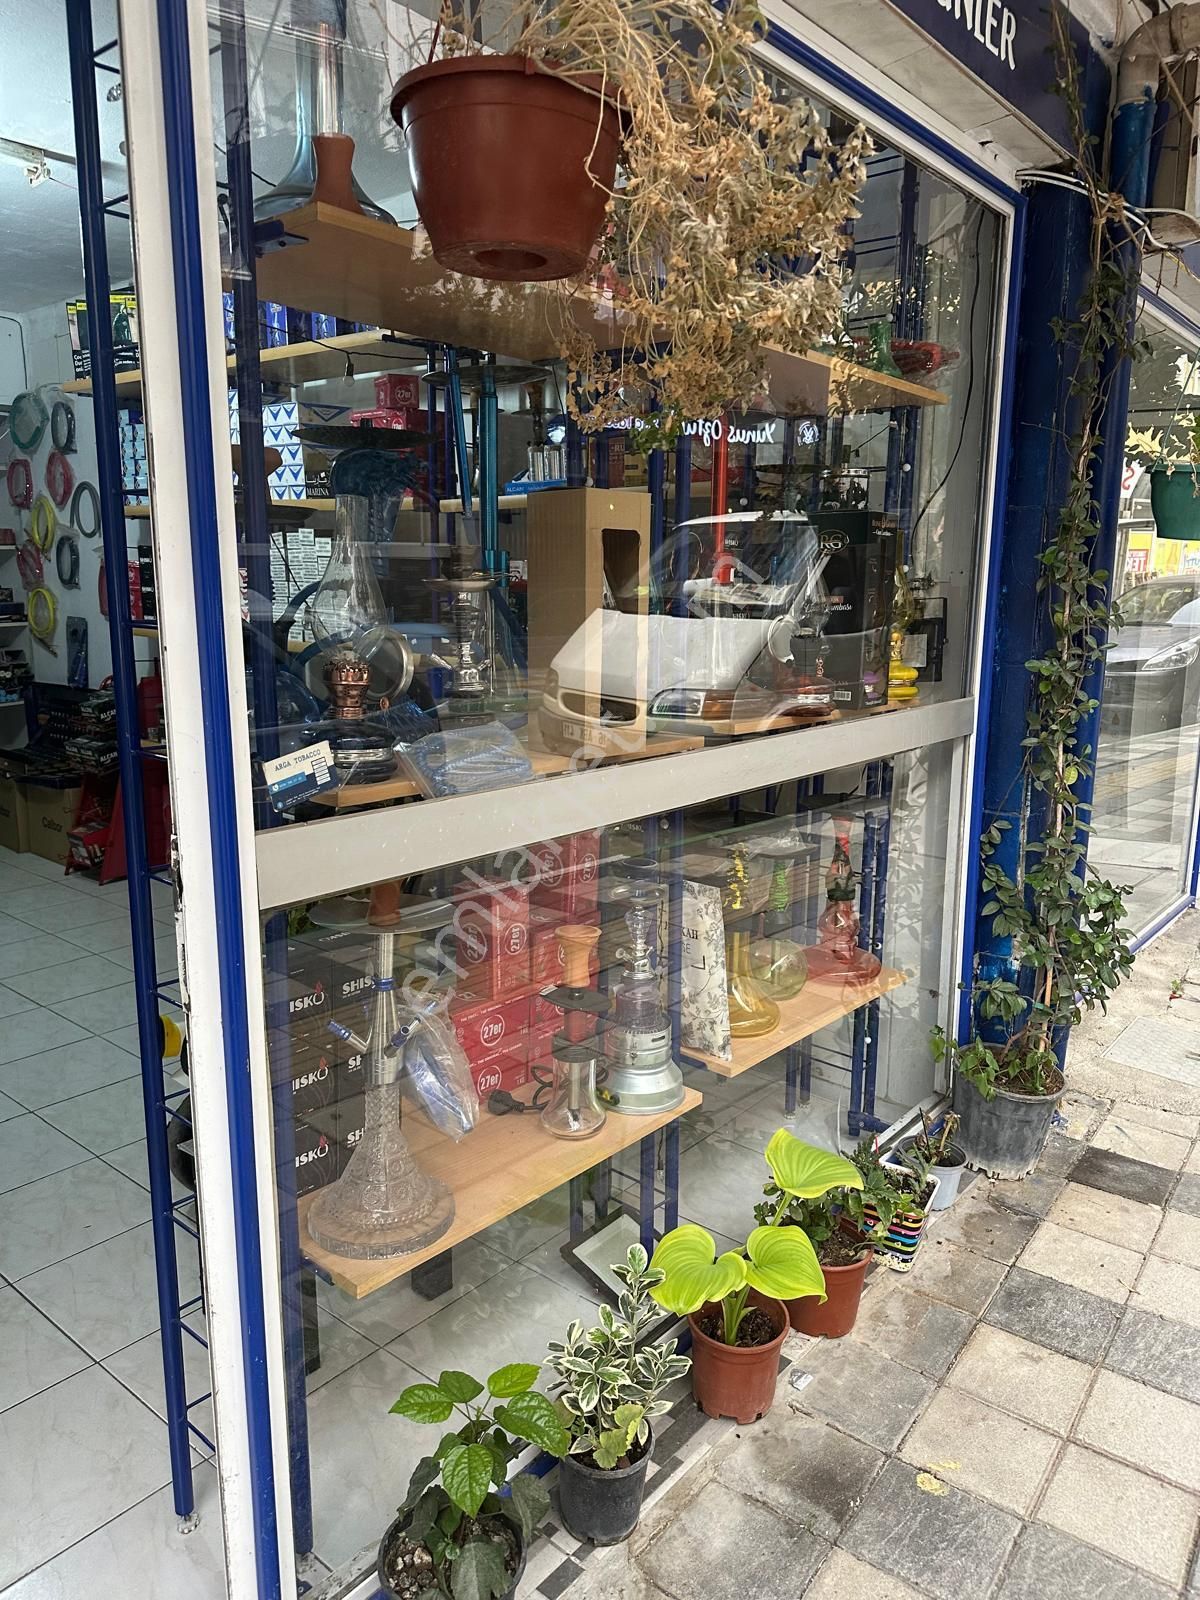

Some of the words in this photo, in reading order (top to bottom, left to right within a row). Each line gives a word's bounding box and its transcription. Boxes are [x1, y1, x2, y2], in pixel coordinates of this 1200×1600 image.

[306, 487, 329, 496] MARINA
[275, 760, 292, 772] ARGA
[294, 748, 321, 765] TOBACCO
[483, 1022, 503, 1039] 27er
[480, 1073, 499, 1091] 27er
